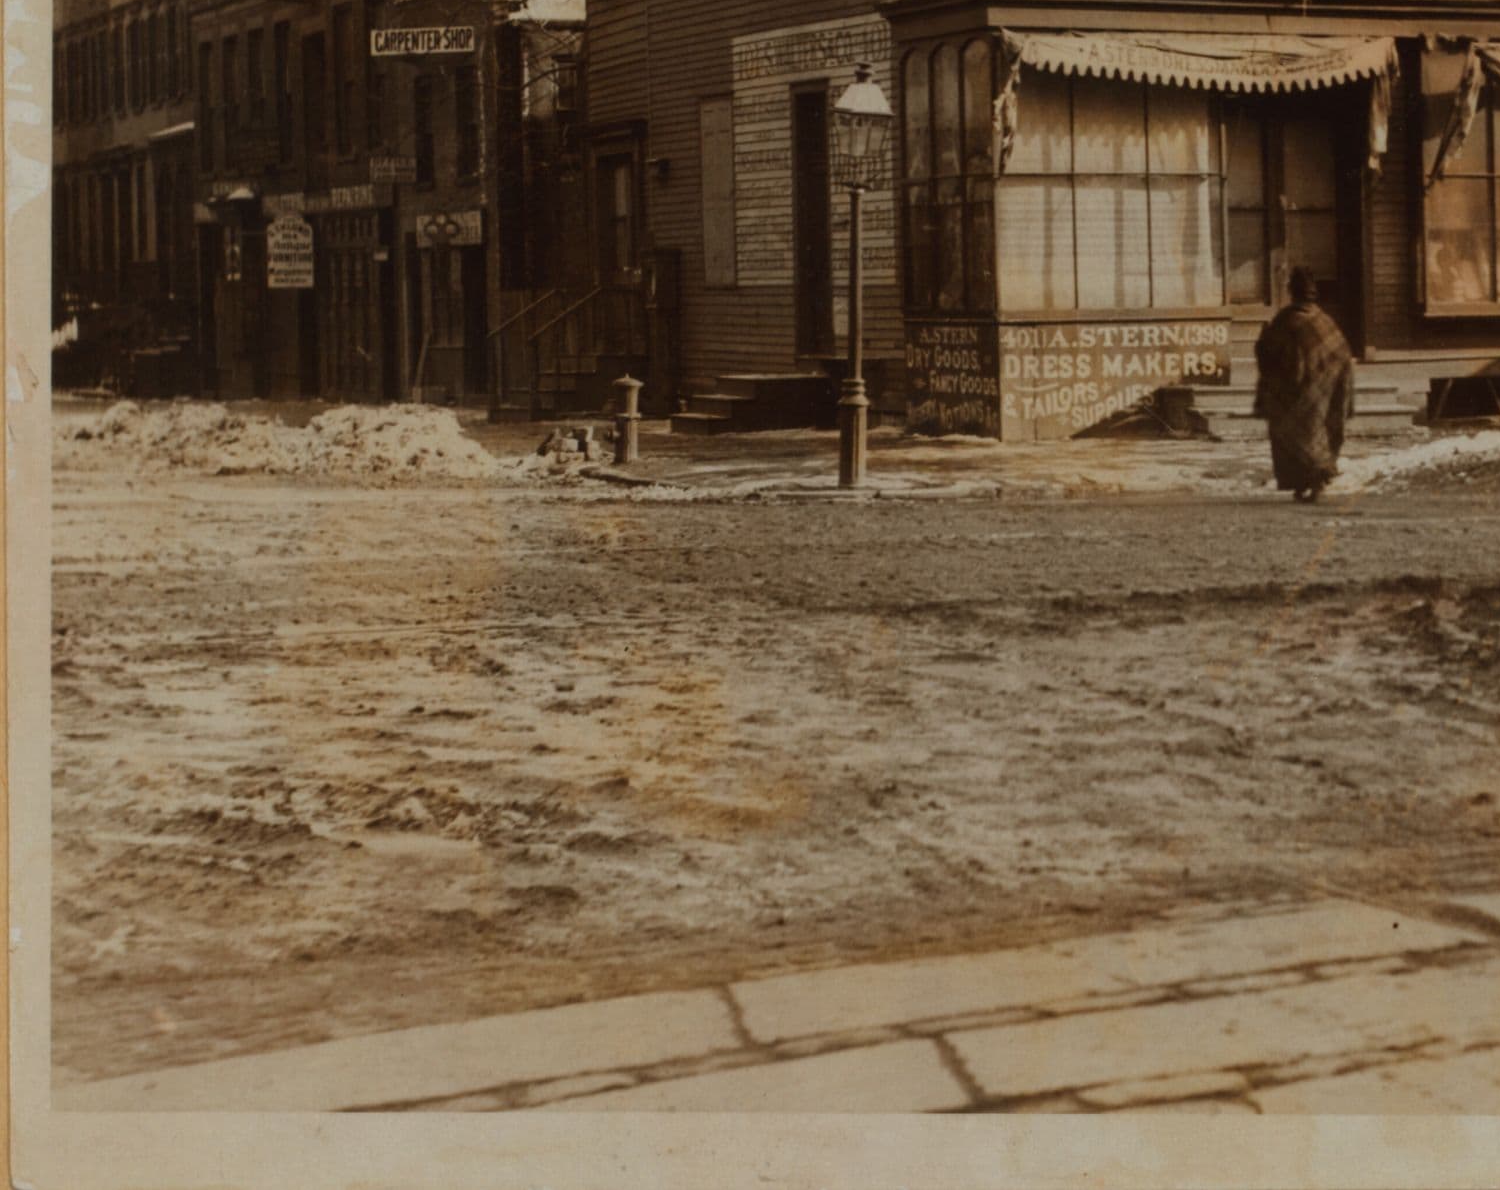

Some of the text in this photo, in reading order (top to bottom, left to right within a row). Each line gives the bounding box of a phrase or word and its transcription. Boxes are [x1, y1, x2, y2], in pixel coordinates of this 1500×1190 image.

[375, 28, 473, 52] CARPENTER SHOP
[906, 343, 931, 371] DRY
[1004, 354, 1091, 379] DRESS
[1023, 381, 1098, 420] TAILORS
